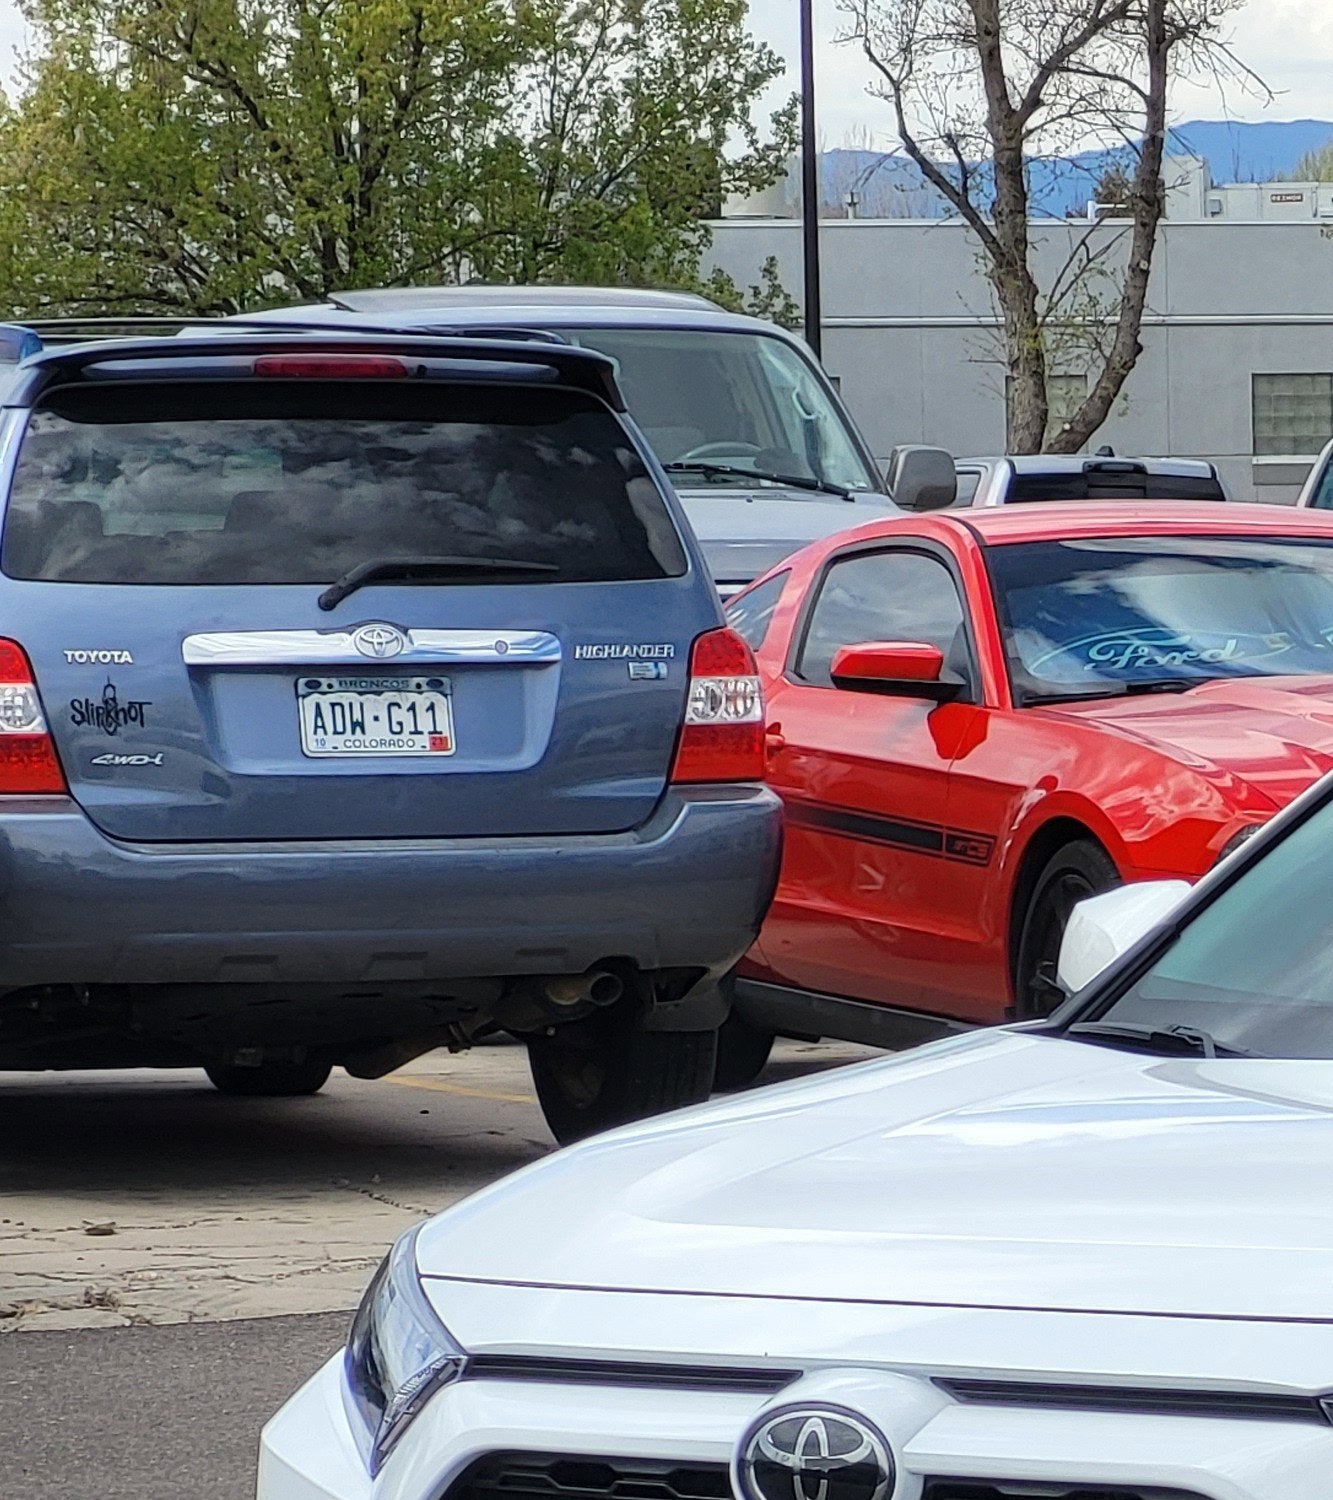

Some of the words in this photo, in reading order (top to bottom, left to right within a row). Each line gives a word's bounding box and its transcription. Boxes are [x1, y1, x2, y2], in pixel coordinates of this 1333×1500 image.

[63, 649, 134, 664] TOYOTA
[574, 643, 675, 660] HIGHLANDER
[1084, 634, 1245, 672] Ford
[338, 679, 411, 690] BRONCOS
[343, 737, 416, 749] COLORADO
